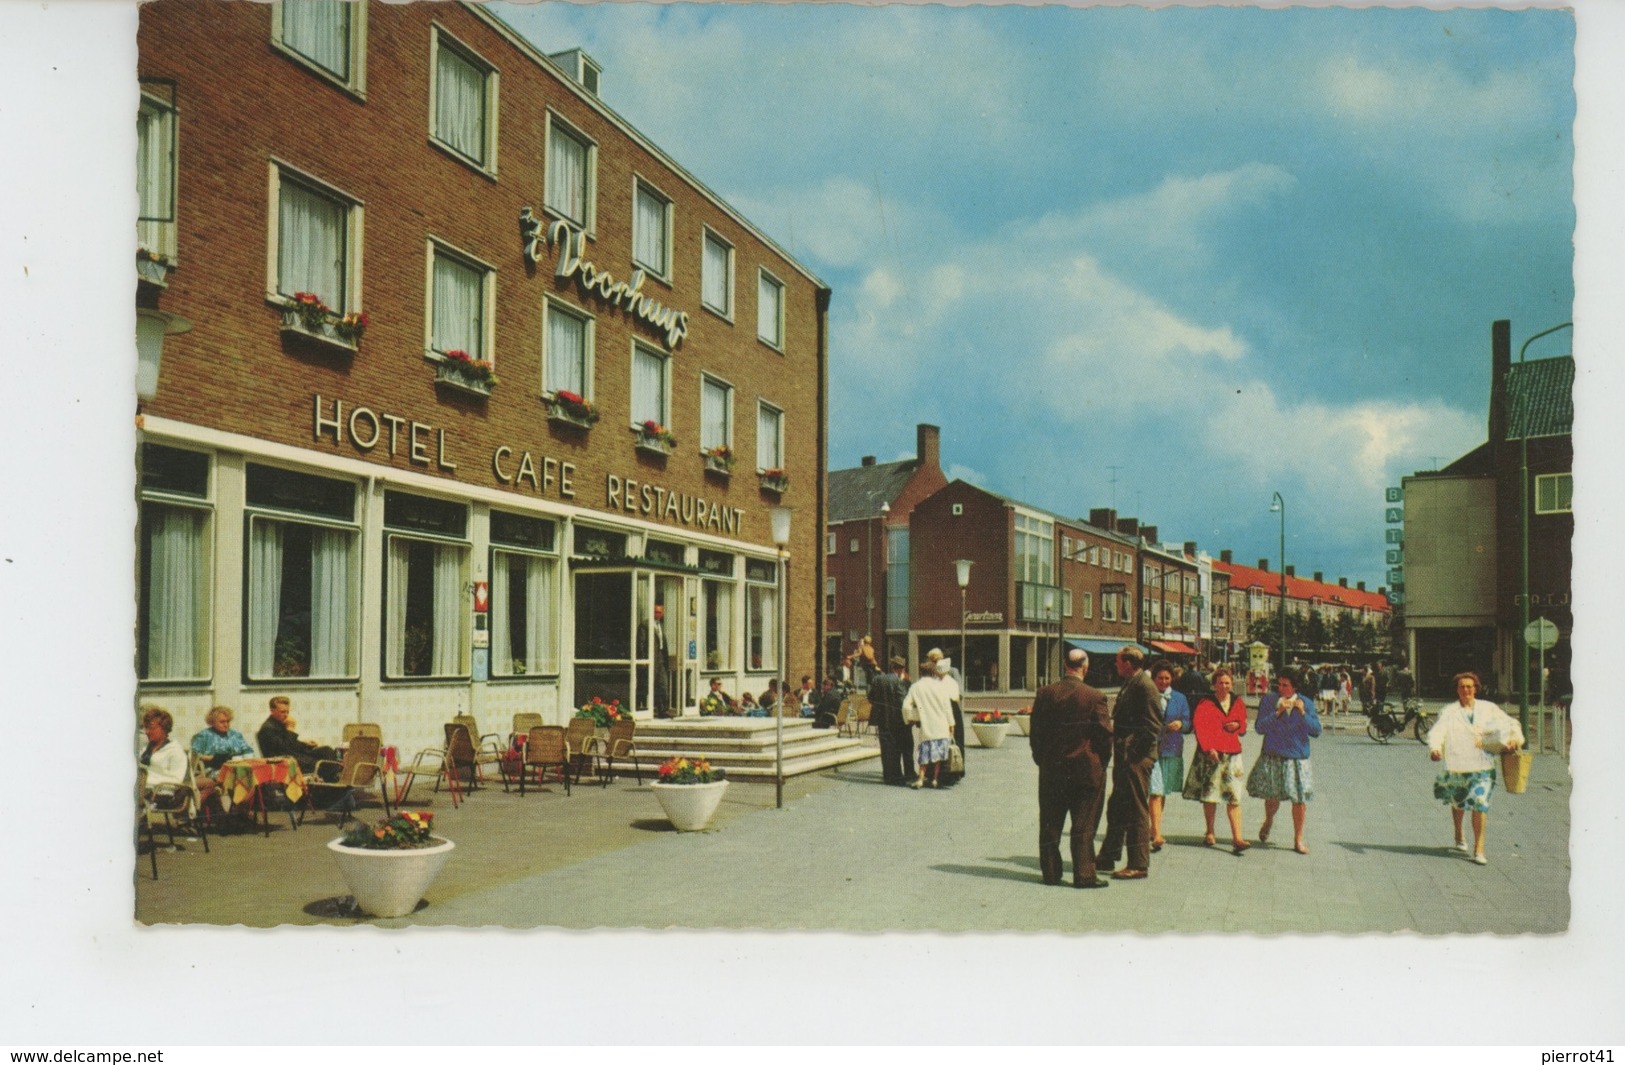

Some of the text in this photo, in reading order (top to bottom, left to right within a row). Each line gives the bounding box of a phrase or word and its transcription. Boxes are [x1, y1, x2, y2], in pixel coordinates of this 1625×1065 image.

[548, 219, 690, 348] Voorhuys
[314, 394, 746, 536] HOTEL CAFE RESTAURANT
[1388, 488, 1400, 604] BATJES
